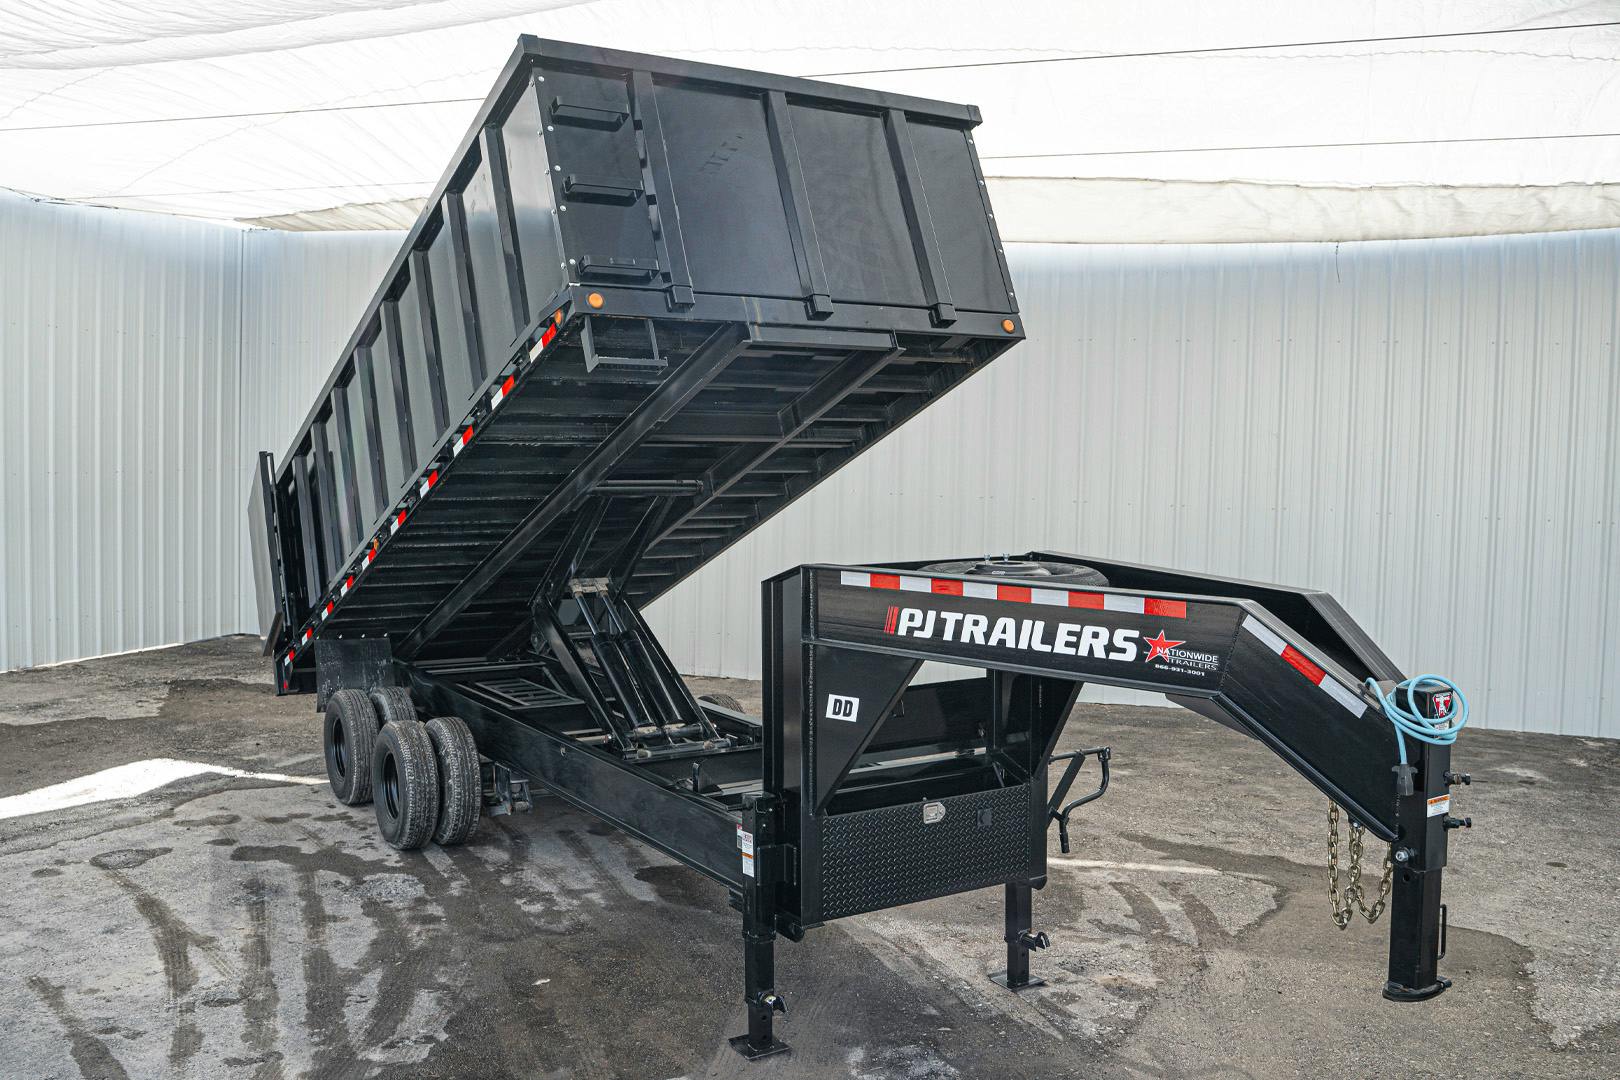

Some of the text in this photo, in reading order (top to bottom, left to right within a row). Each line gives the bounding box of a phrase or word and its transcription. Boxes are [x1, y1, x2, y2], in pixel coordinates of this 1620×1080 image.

[898, 607, 1140, 662] PJ TRAILERS
[1156, 646, 1218, 663] NATIONWIDE
[1155, 663, 1205, 677] 866-931-3001
[1170, 658, 1217, 671] TRAILERS
[832, 698, 853, 717] DD
